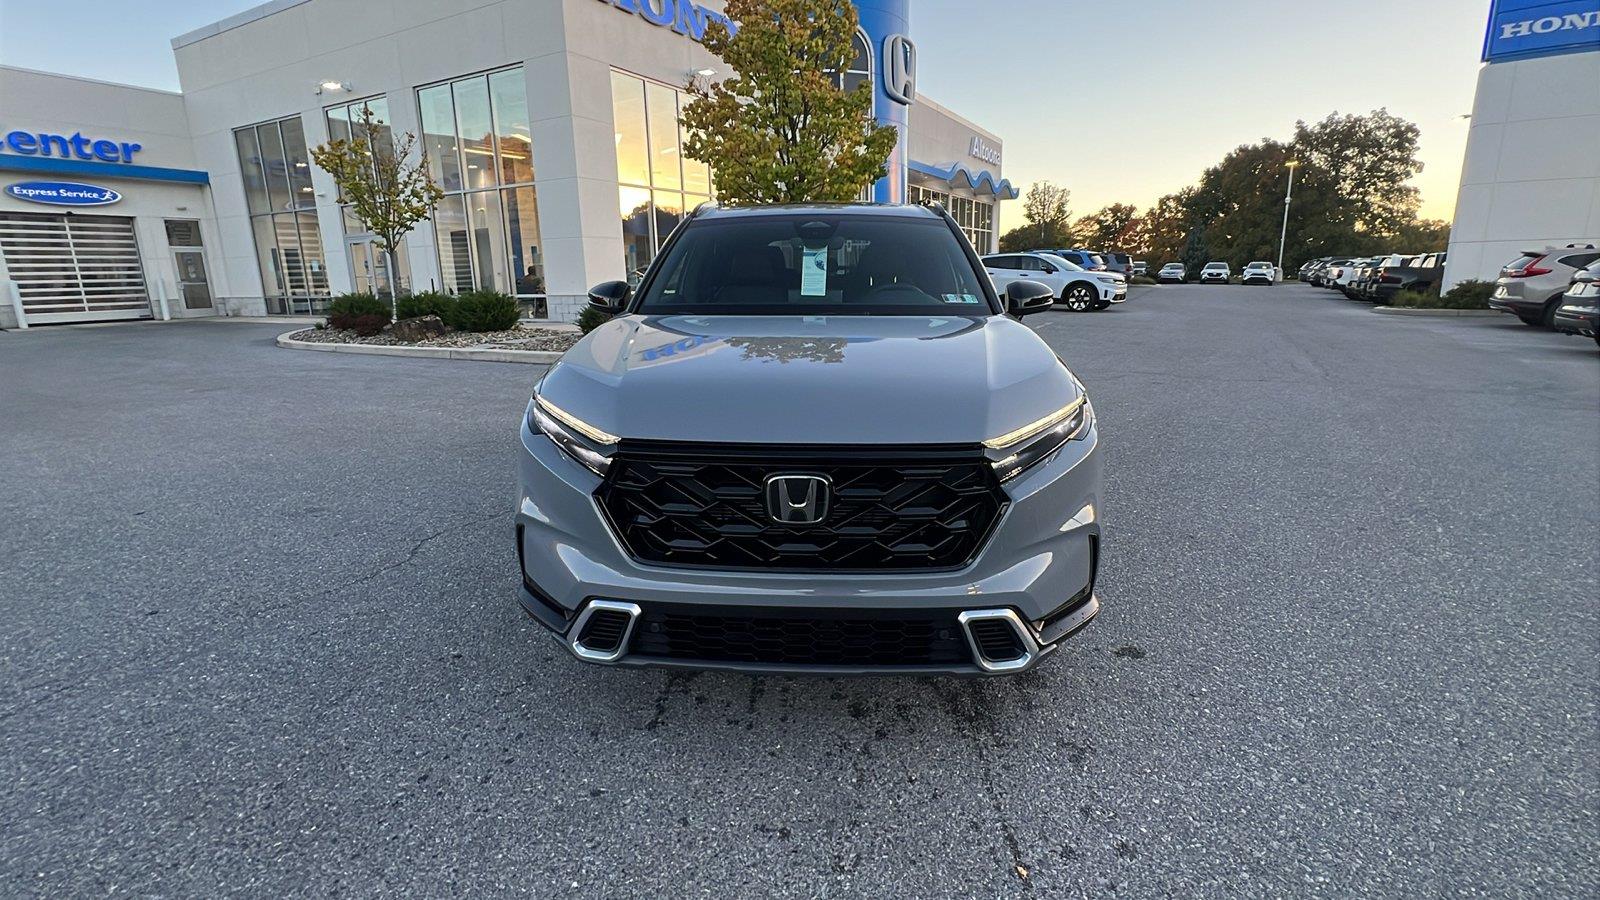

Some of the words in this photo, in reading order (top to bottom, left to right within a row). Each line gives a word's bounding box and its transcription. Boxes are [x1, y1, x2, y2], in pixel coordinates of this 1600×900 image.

[0, 130, 142, 163] enter
[13, 186, 57, 198] Express
[59, 188, 99, 199] Service
